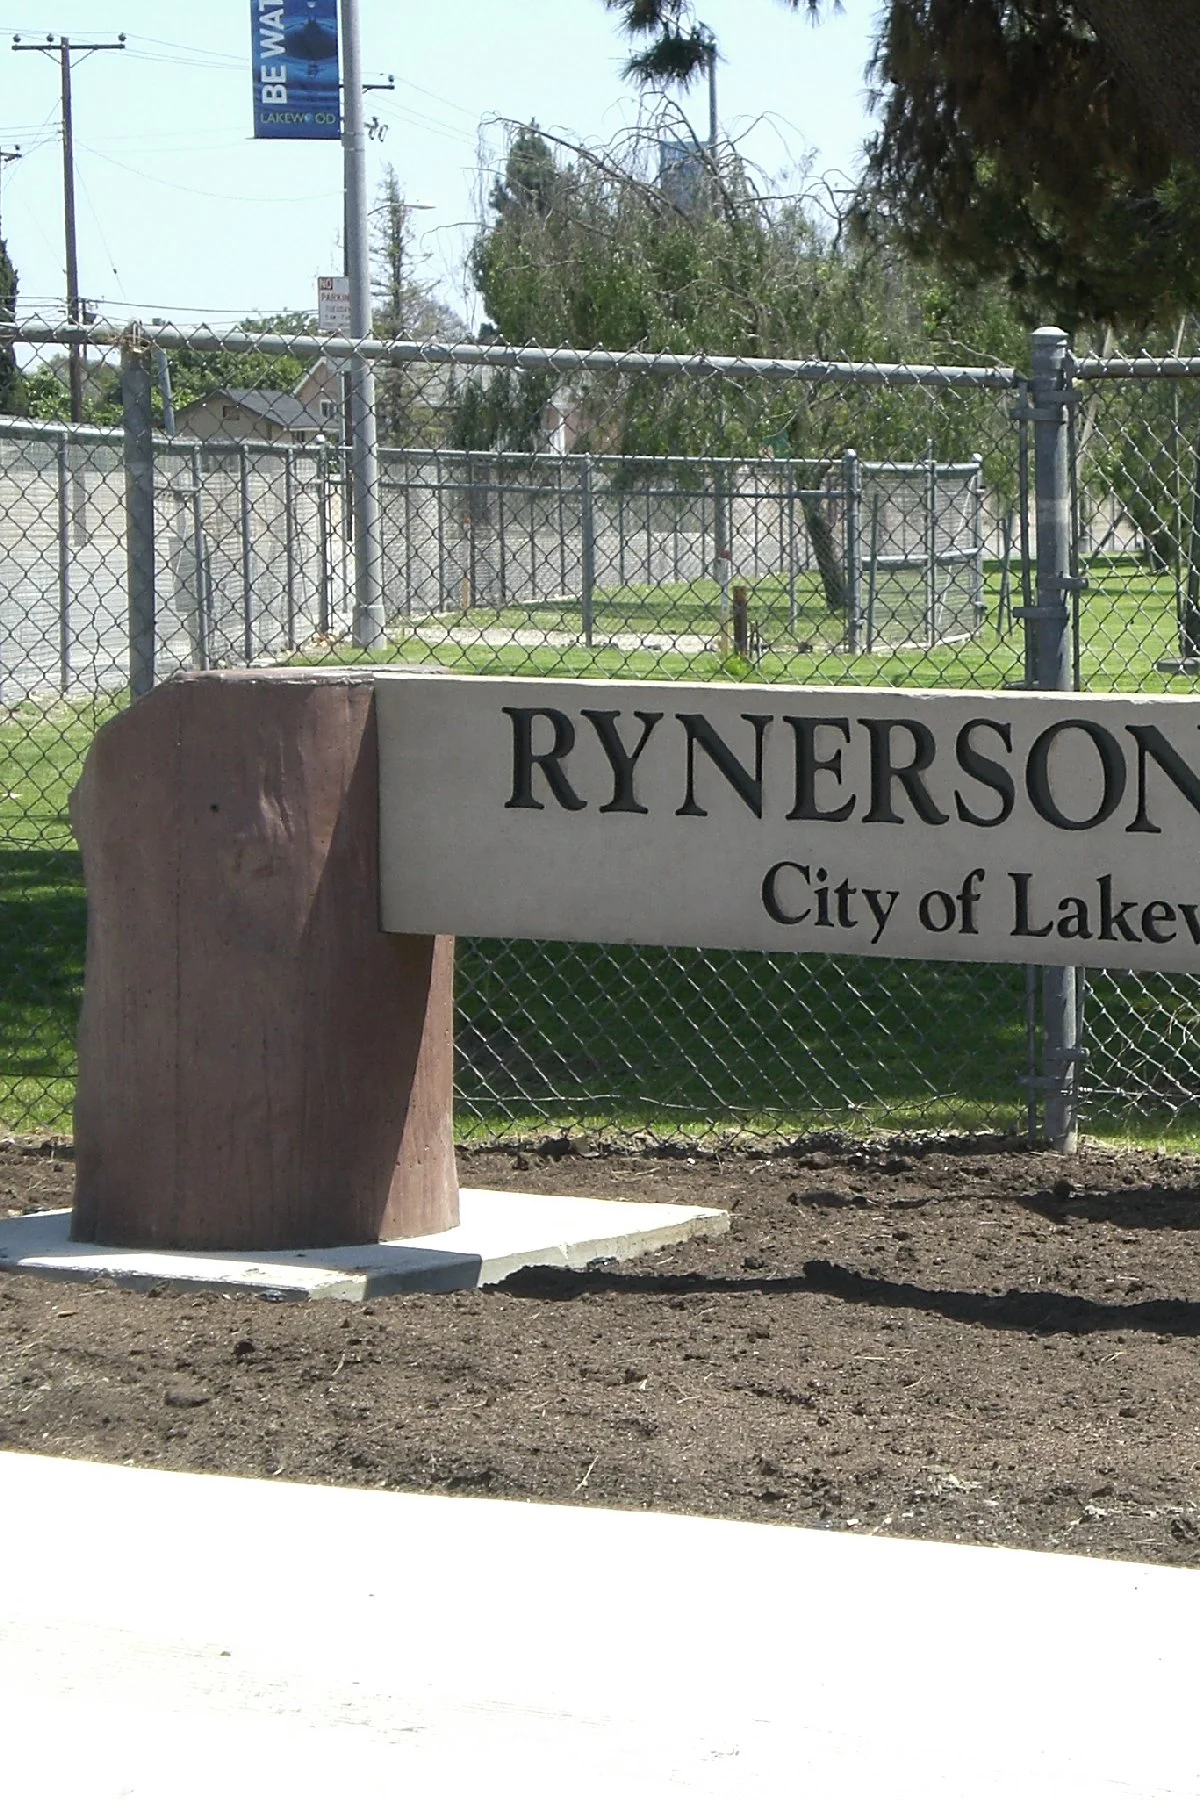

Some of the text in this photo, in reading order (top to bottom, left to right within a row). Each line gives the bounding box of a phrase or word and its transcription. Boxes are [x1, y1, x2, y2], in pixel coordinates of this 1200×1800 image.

[261, 64, 288, 104] BE
[320, 278, 332, 289] NO
[761, 860, 899, 945] City
[918, 868, 985, 935] of
